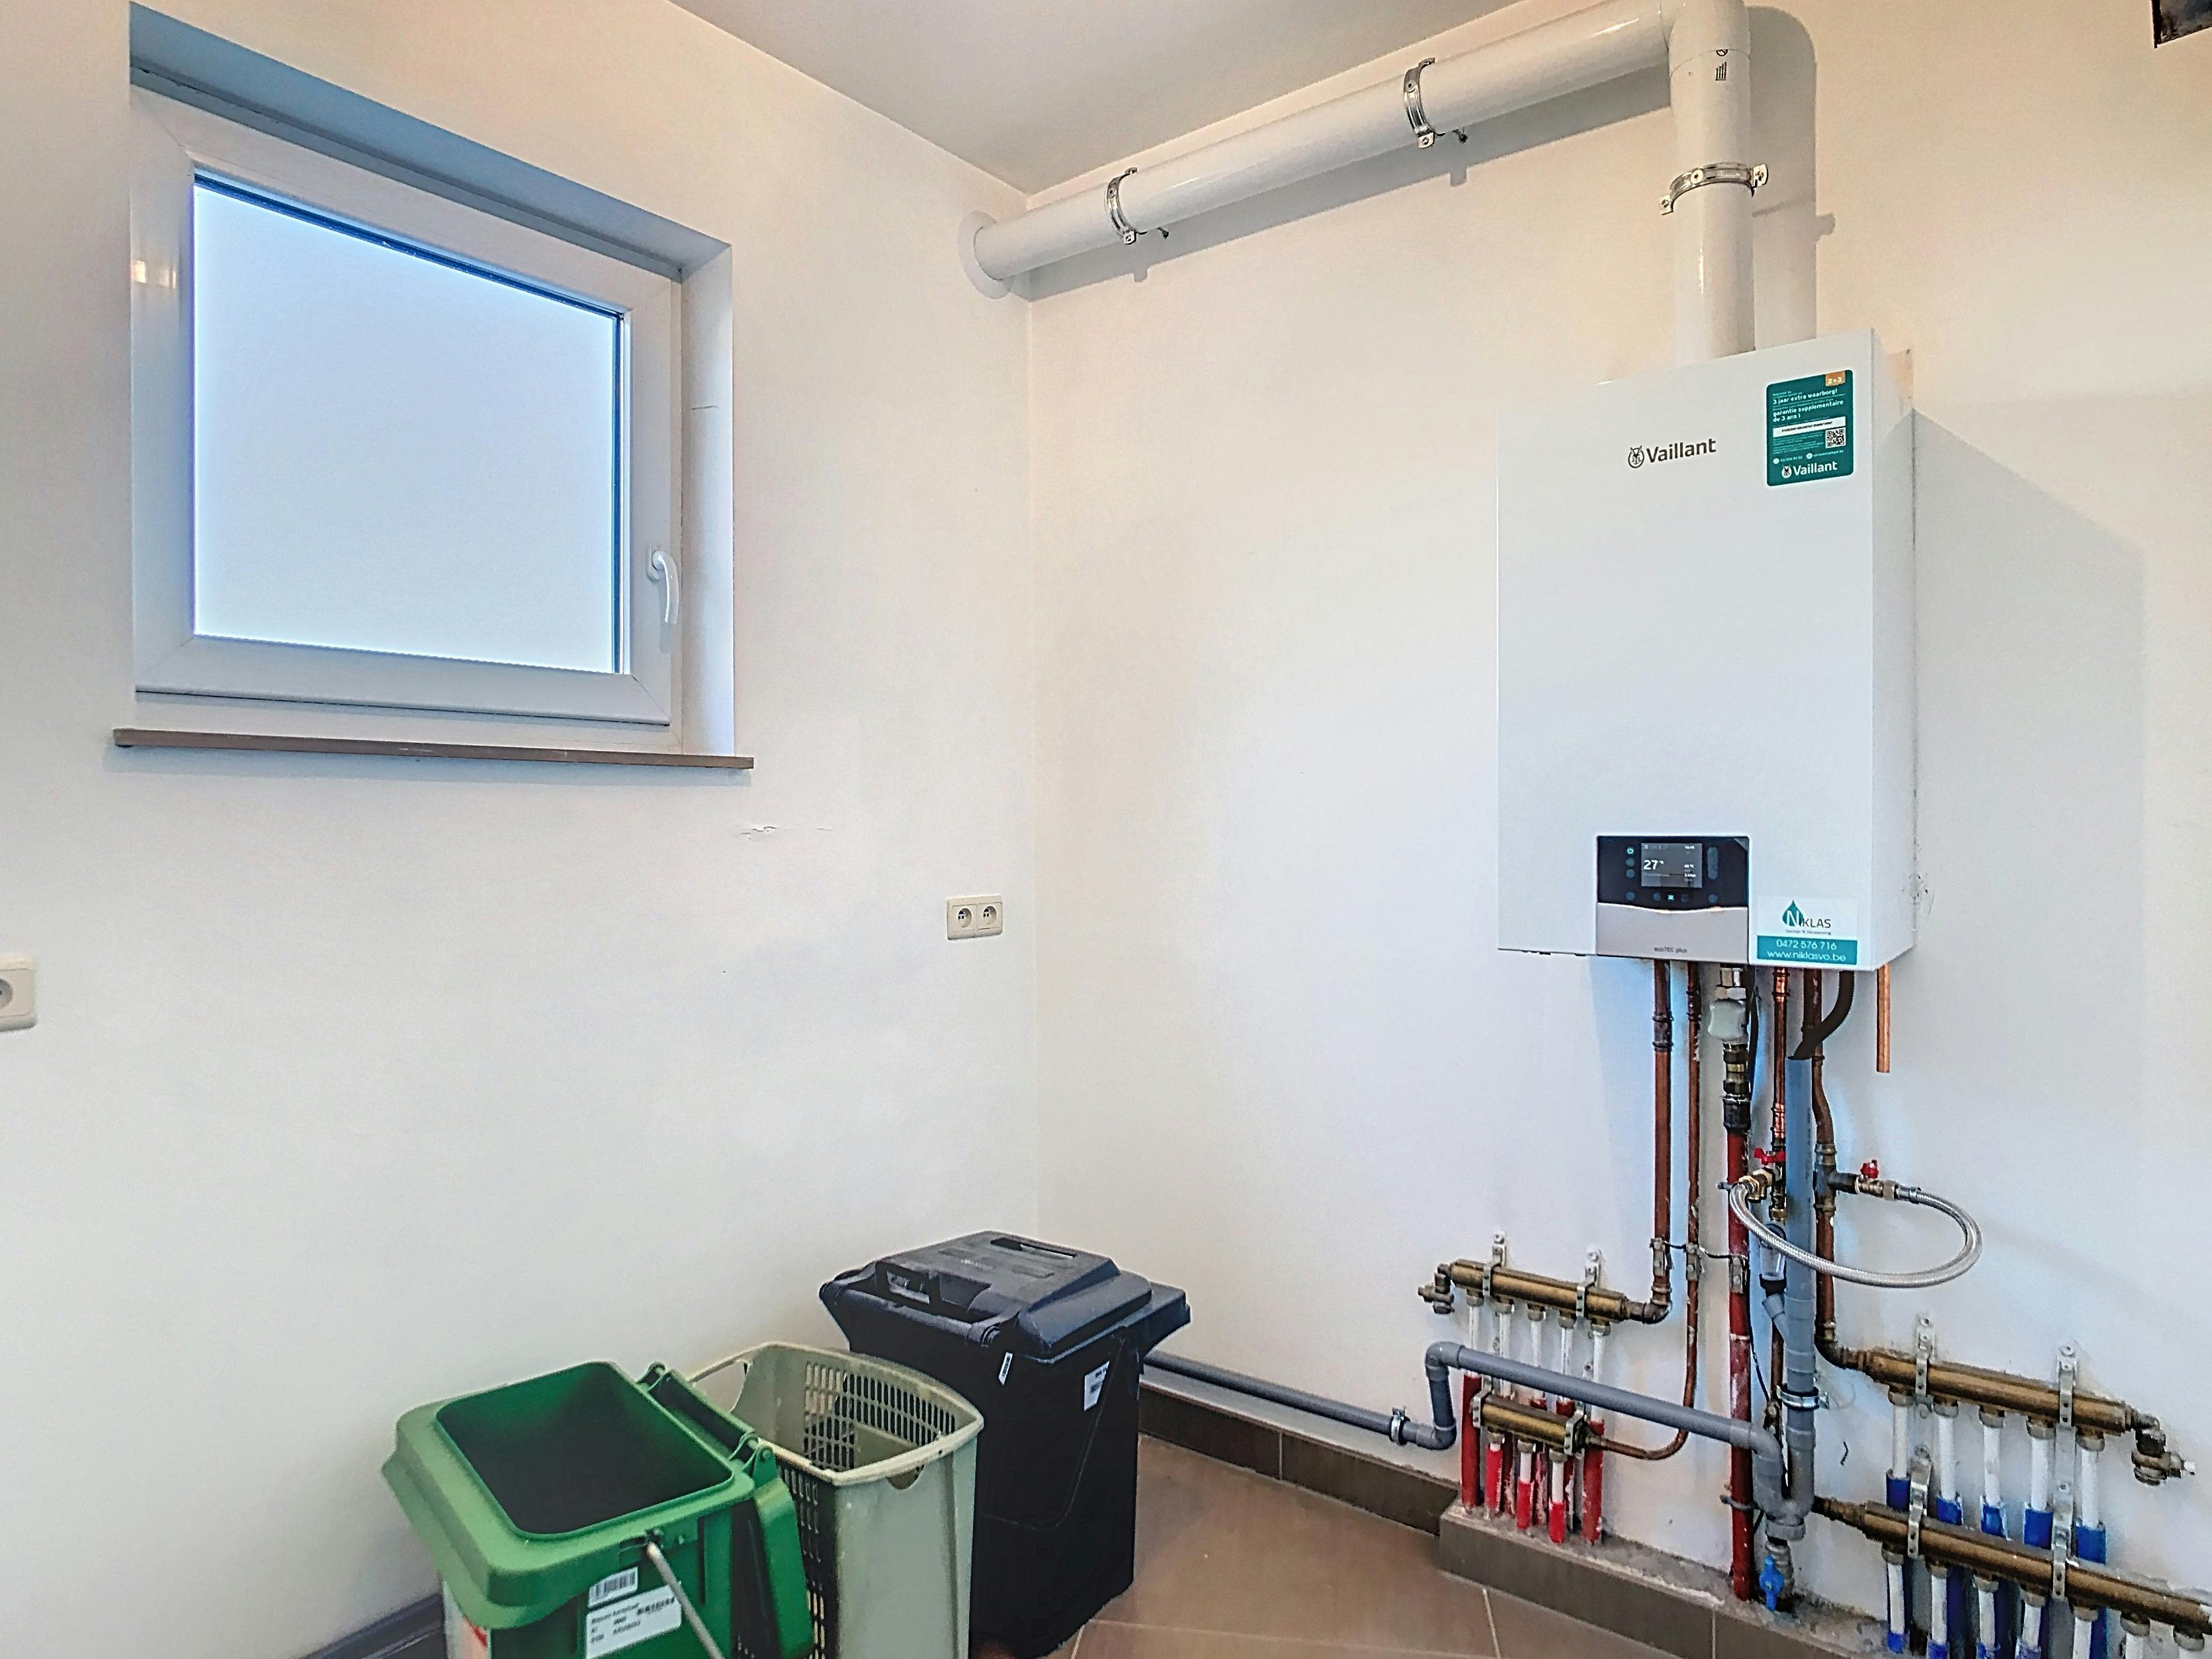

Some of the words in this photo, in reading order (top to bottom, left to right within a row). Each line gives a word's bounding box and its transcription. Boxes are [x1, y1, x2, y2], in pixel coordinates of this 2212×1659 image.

[1807, 388, 1838, 398] waarborg!
[1773, 407, 1797, 417] garantie
[1646, 438, 1717, 463] Vaillant
[1793, 461, 1838, 476] Vaillant
[1643, 859, 1658, 871] 27
[1776, 939, 1799, 949] 0472
[1801, 940, 1818, 950] 576
[1820, 941, 1837, 951] 716
[1767, 951, 1846, 962] www.niklasvo.be
